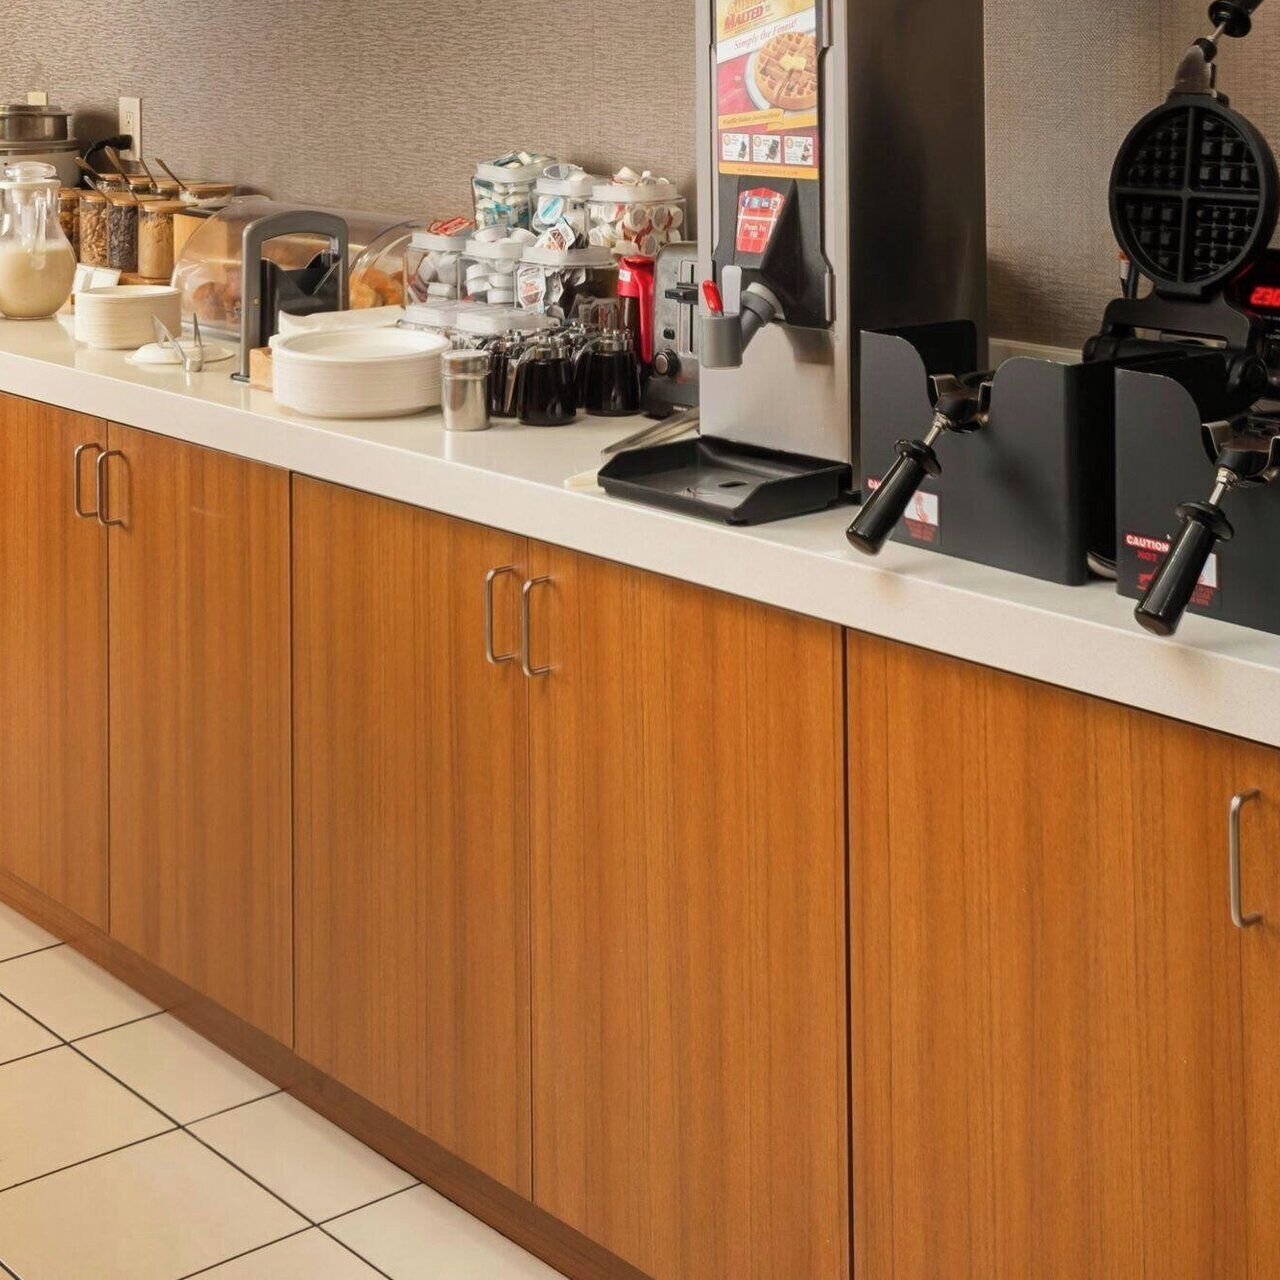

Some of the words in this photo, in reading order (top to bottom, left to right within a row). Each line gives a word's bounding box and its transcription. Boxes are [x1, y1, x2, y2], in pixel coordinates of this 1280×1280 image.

[724, 5, 764, 32] MALTED
[734, 34, 758, 49] Simply
[1125, 534, 1170, 552] CAUTION
